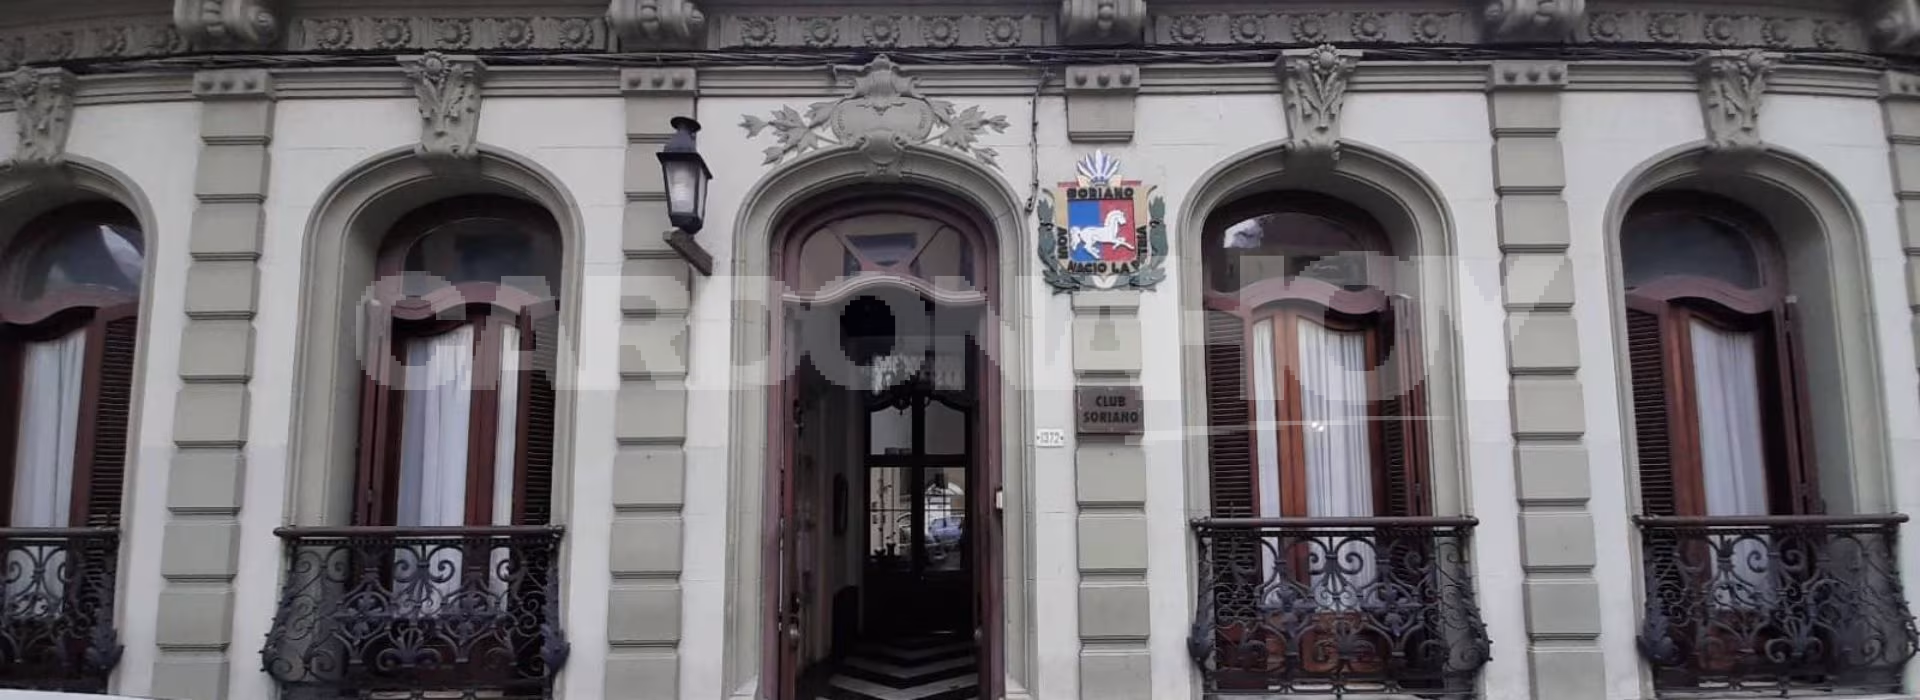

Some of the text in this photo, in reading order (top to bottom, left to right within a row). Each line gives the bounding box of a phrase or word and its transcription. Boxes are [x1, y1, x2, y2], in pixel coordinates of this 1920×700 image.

[1067, 187, 1134, 199] SORIANO
[1067, 262, 1107, 273] NACIO
[1112, 262, 1131, 273] LA
[1095, 396, 1126, 407] CLUB
[1083, 411, 1138, 423] SORIANO
[1040, 431, 1060, 443] 1372
